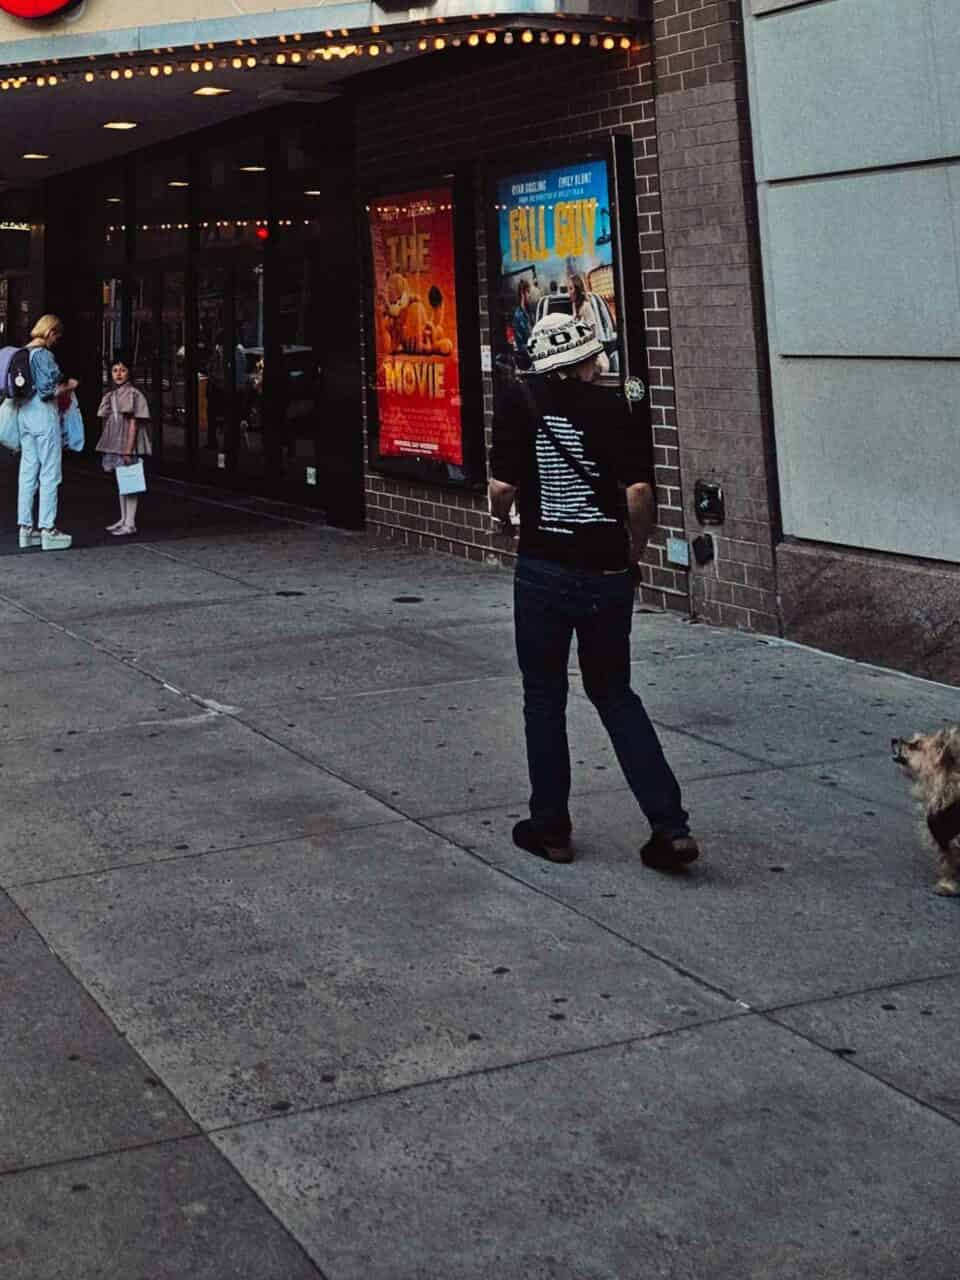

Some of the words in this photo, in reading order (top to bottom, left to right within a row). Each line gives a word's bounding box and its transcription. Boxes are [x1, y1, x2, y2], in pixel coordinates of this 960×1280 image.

[509, 206, 548, 262] FALL
[554, 197, 597, 257] GUY
[386, 233, 431, 273] THE
[383, 362, 445, 400] MOVIE
